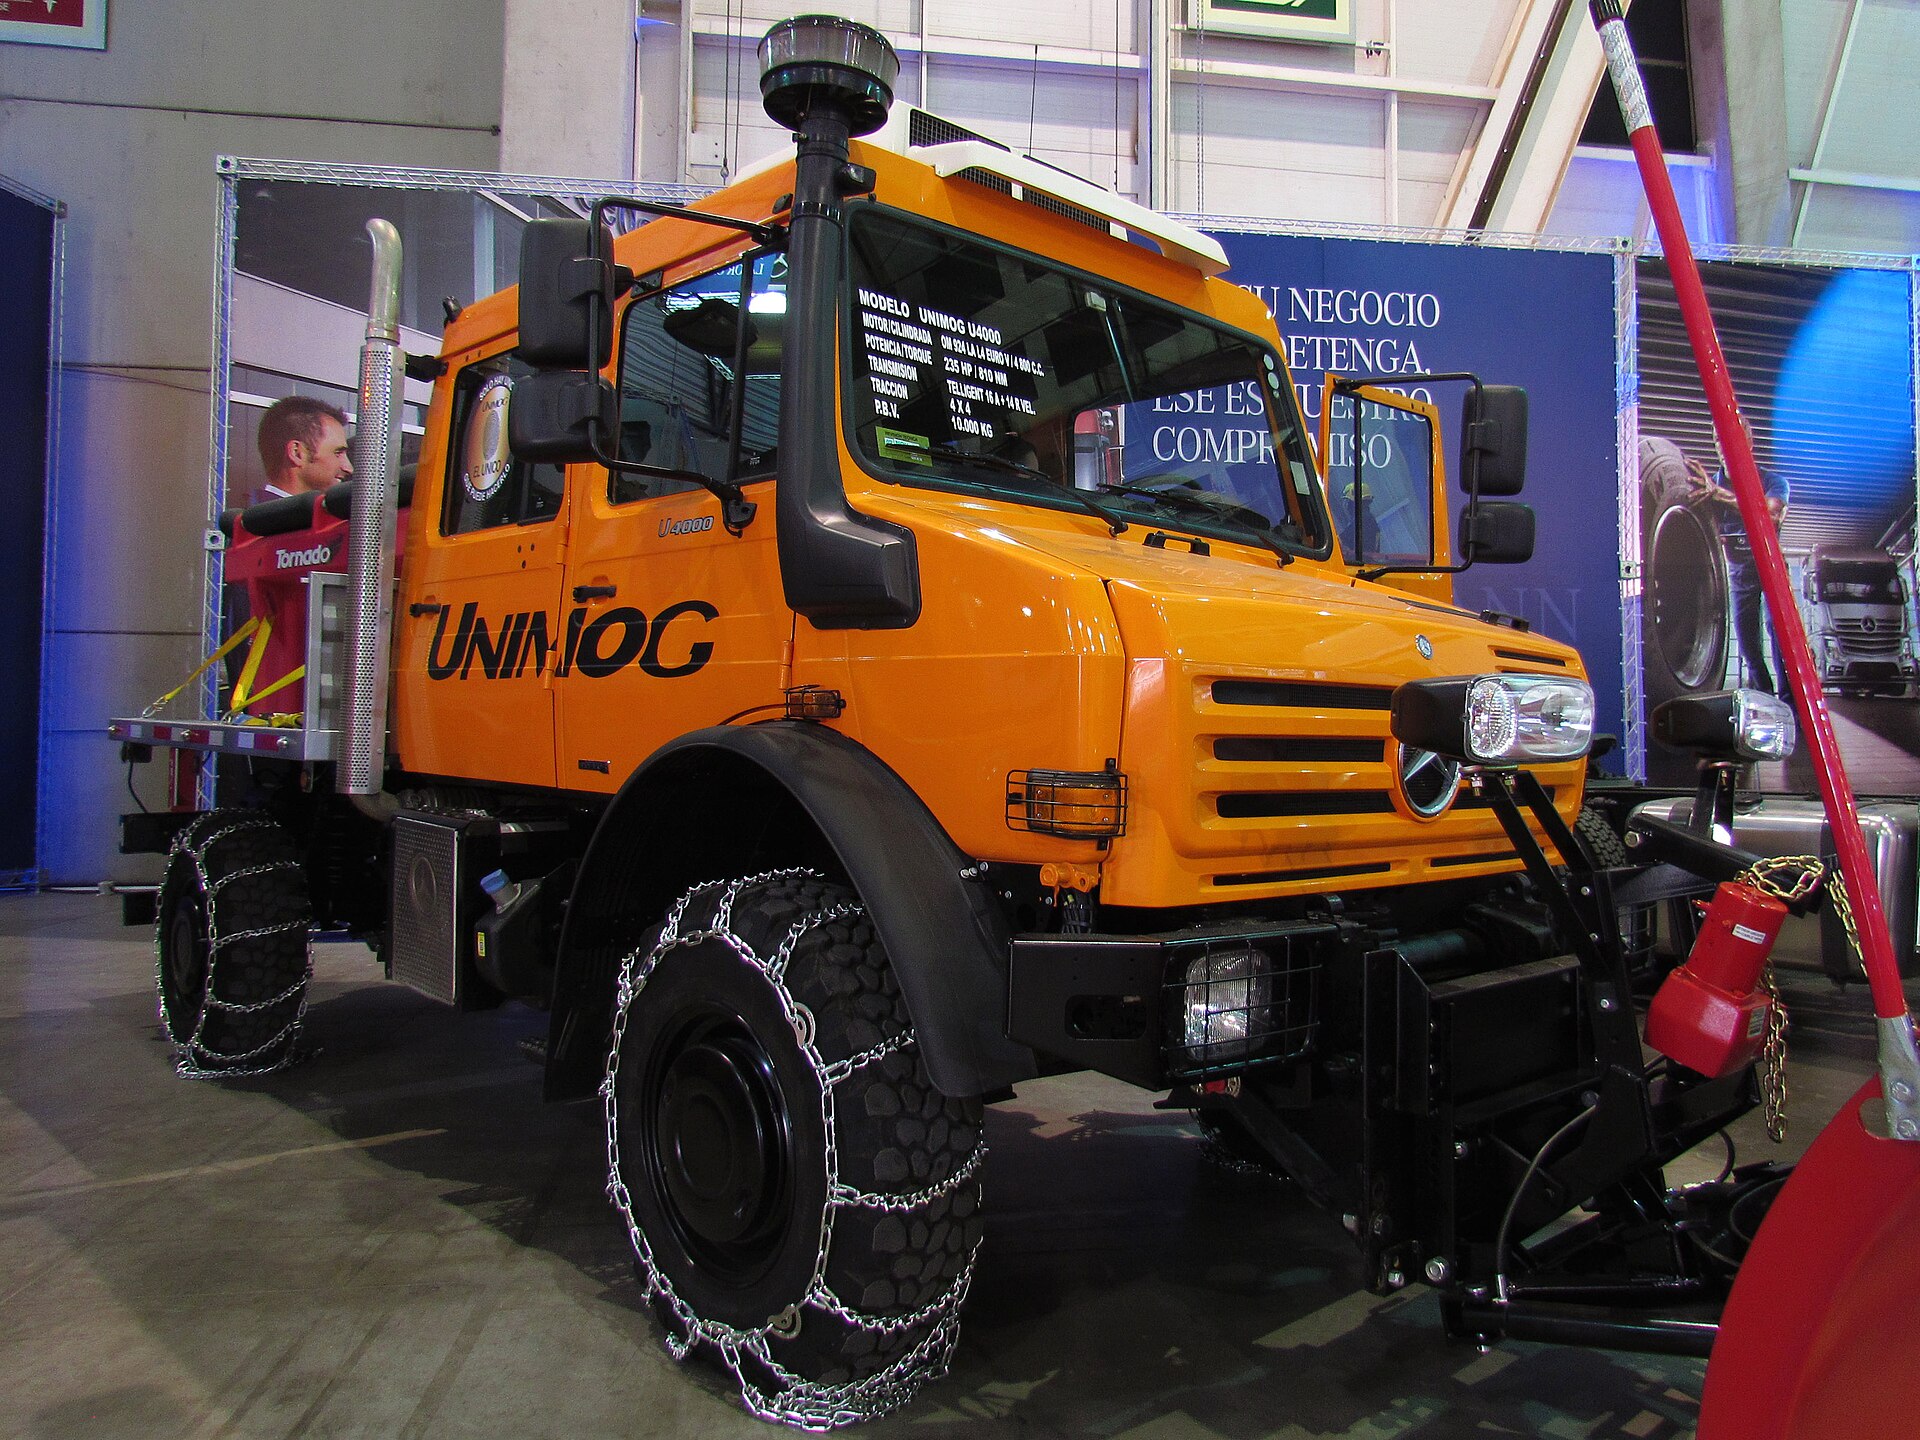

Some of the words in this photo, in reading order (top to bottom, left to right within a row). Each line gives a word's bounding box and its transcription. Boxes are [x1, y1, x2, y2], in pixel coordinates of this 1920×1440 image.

[858, 288, 910, 318] MODELO
[918, 306, 966, 335] UNIMOG
[967, 321, 1002, 346] U4000
[1287, 287, 1440, 328] NEGOCIO
[862, 311, 933, 346] MOTOR/CILINDRADA
[940, 334, 953, 351] OM
[985, 347, 1004, 366] EURO
[864, 332, 933, 366] POTENCIA/TORQUE
[943, 356, 960, 374] 235
[960, 360, 973, 377] HP
[978, 366, 994, 383] 810
[867, 354, 918, 382] TRANSMISION
[946, 379, 984, 402] TELLIGENT
[985, 389, 994, 405] 16
[994, 392, 1001, 407] A
[1006, 394, 1015, 410] 14
[1020, 398, 1037, 416] VEL.
[870, 376, 909, 400] TRACCION
[949, 397, 956, 413] 4
[956, 399, 964, 415] X
[965, 401, 972, 416] 4
[1224, 380, 1265, 415] ES
[874, 398, 900, 419] P.B.V.
[951, 415, 980, 435] 10.000
[980, 421, 994, 438] KG
[276, 544, 331, 569] Tornado
[427, 600, 720, 681] UNIMOG
